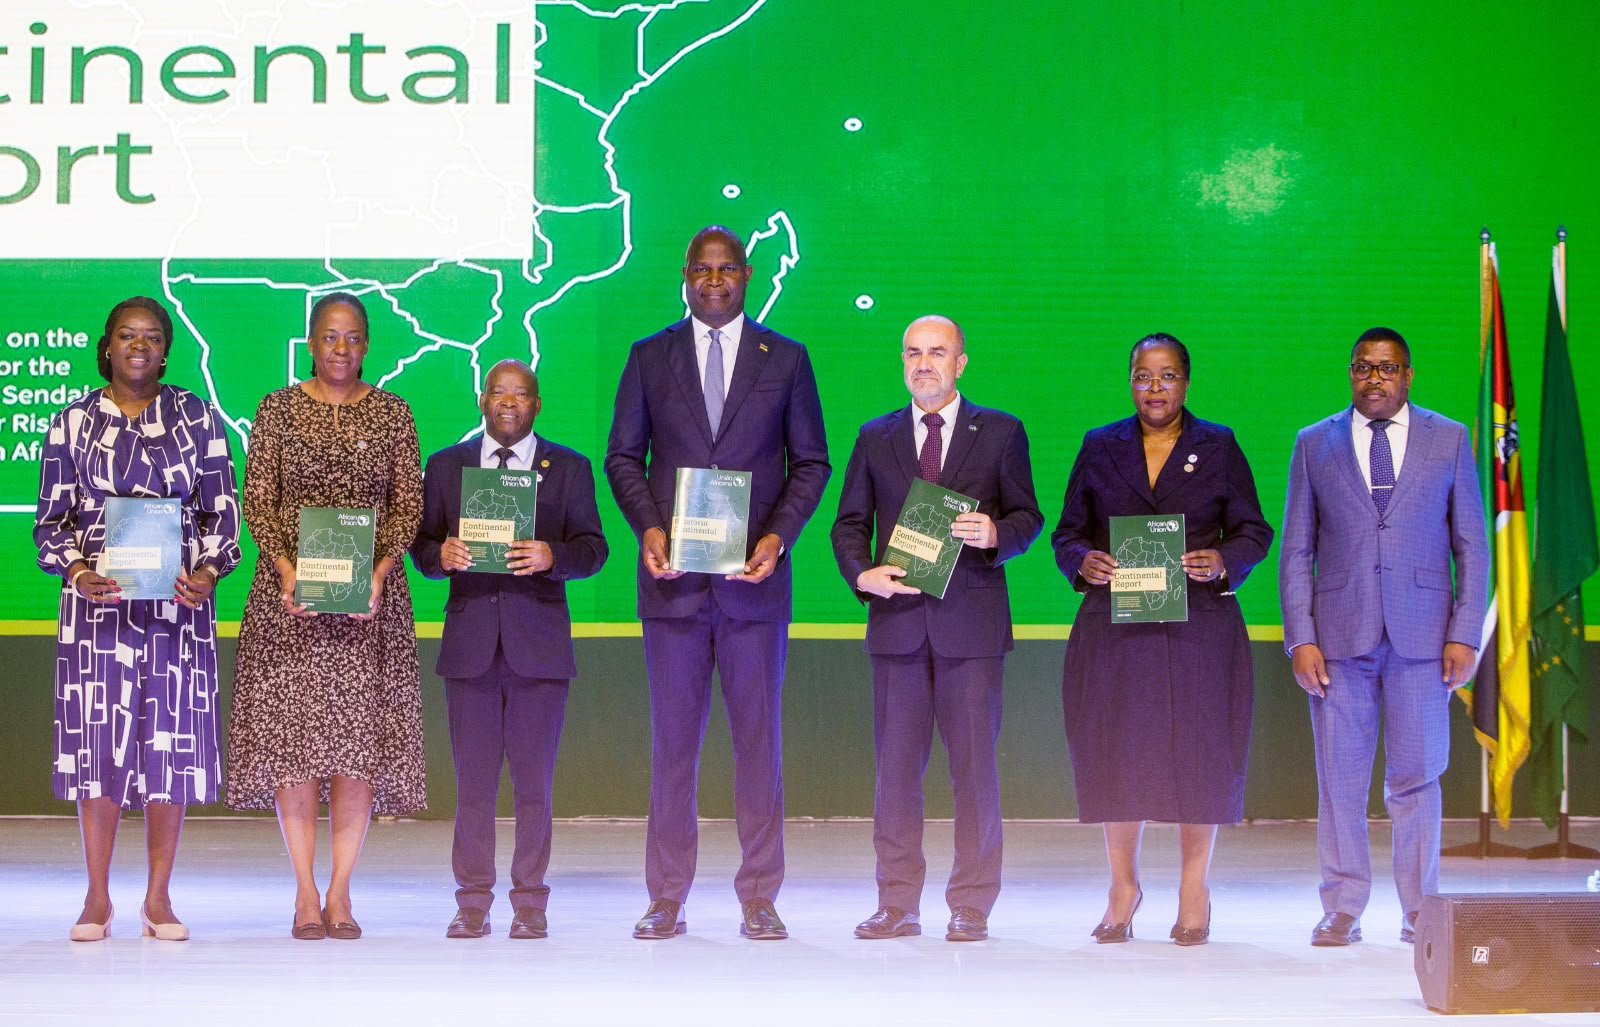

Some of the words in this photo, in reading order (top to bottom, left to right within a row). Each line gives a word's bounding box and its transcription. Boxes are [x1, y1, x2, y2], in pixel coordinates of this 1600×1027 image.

[0, 22, 511, 105] inental
[6, 332, 40, 348] on
[46, 327, 88, 348] the
[28, 355, 71, 376] the
[12, 412, 56, 433] Ris
[11, 440, 43, 461] Af
[943, 500, 960, 511] Union
[463, 521, 511, 532] Continental
[462, 530, 489, 539] Report
[896, 529, 938, 551] Continental
[893, 537, 917, 552] Report
[108, 550, 158, 559] Continental
[109, 558, 137, 567] Report
[300, 561, 349, 571] Continental
[300, 569, 328, 578] Report
[1114, 571, 1162, 580] Continental
[1114, 580, 1142, 589] Report
